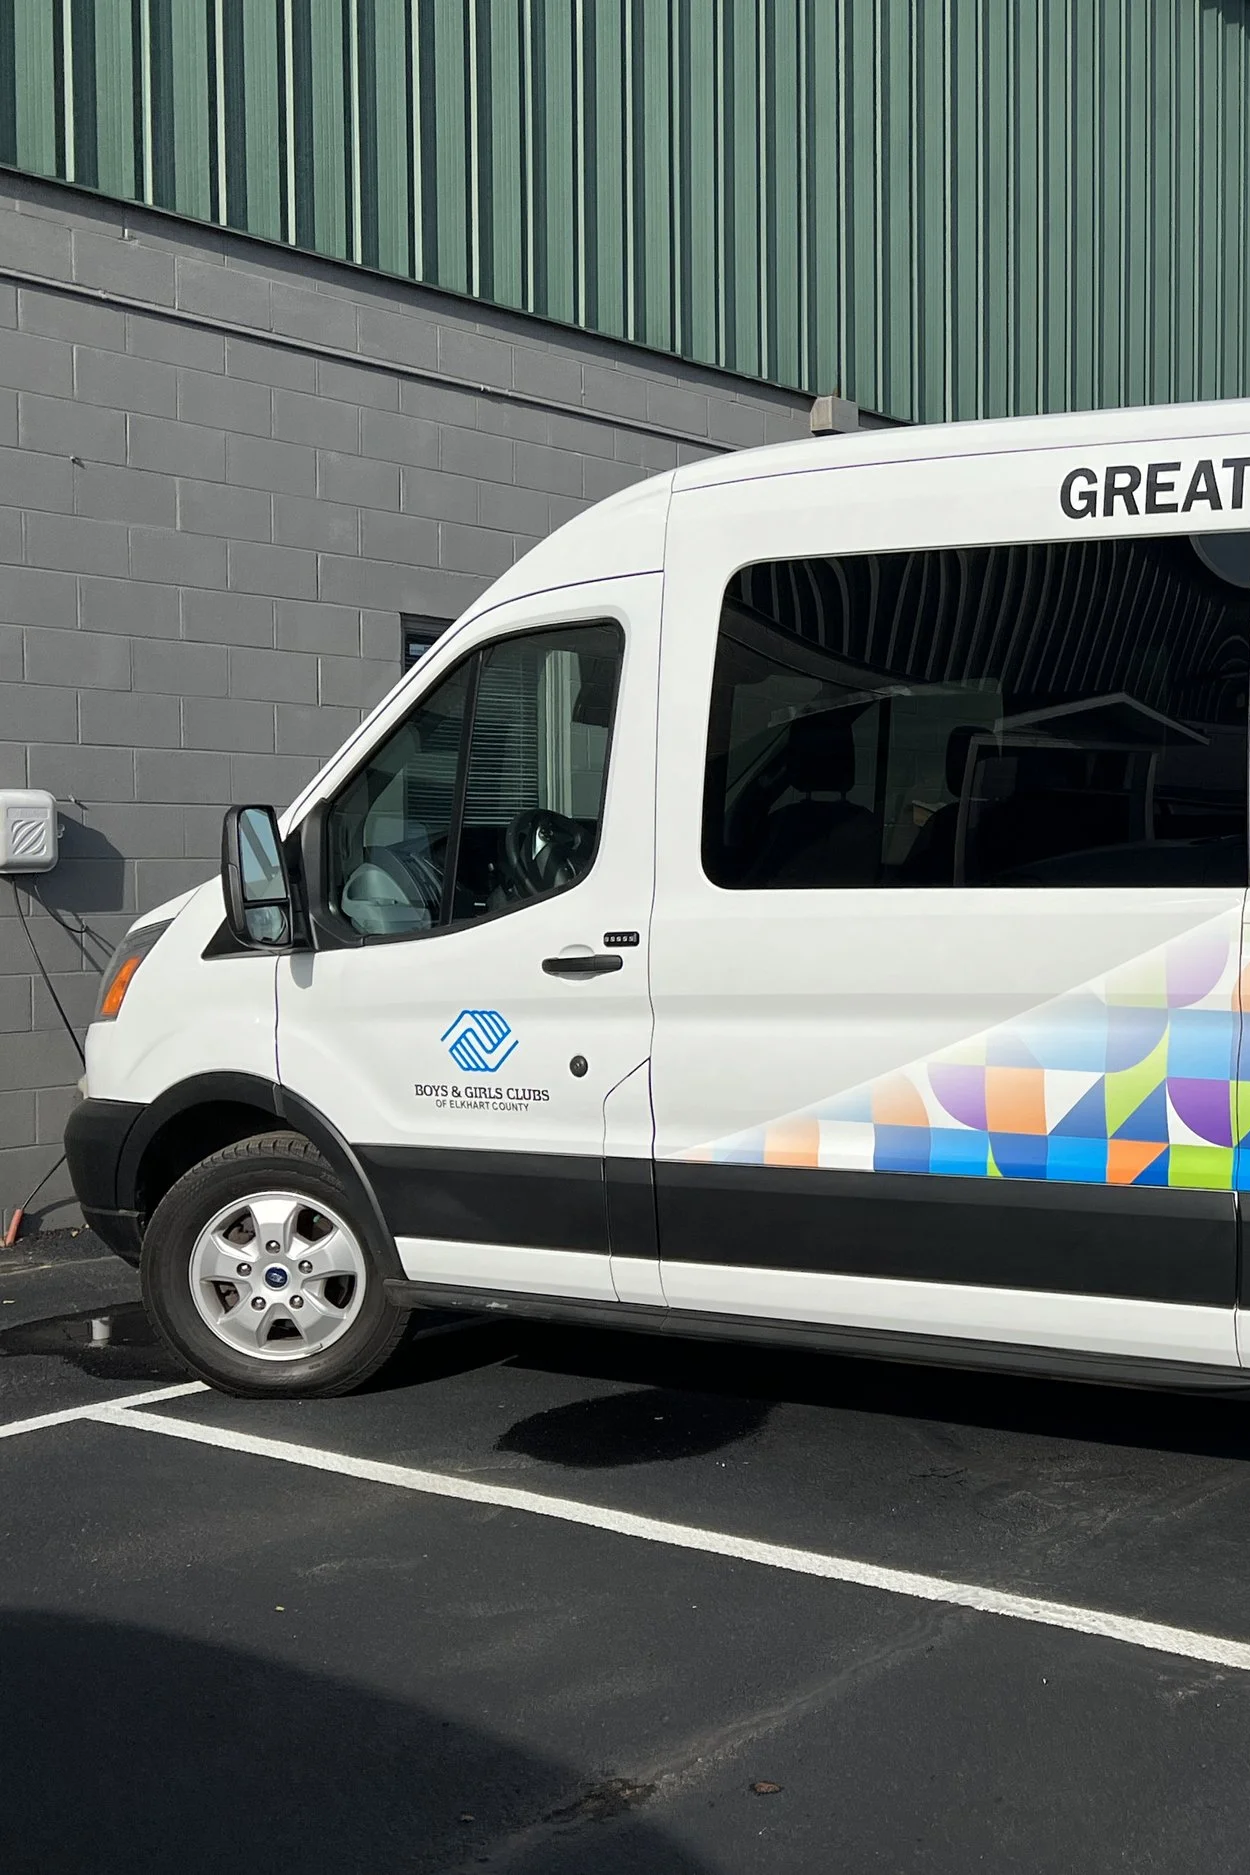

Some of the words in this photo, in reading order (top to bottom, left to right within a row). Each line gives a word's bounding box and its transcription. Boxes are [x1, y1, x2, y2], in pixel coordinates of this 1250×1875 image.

[415, 1084, 448, 1097] BOYS
[452, 1086, 462, 1098] &
[464, 1087, 503, 1099] GIRLS
[506, 1088, 550, 1101] CLUBS
[436, 1099, 447, 1108] OF
[450, 1100, 490, 1110] ELKHART
[492, 1102, 529, 1111] COUNTY
